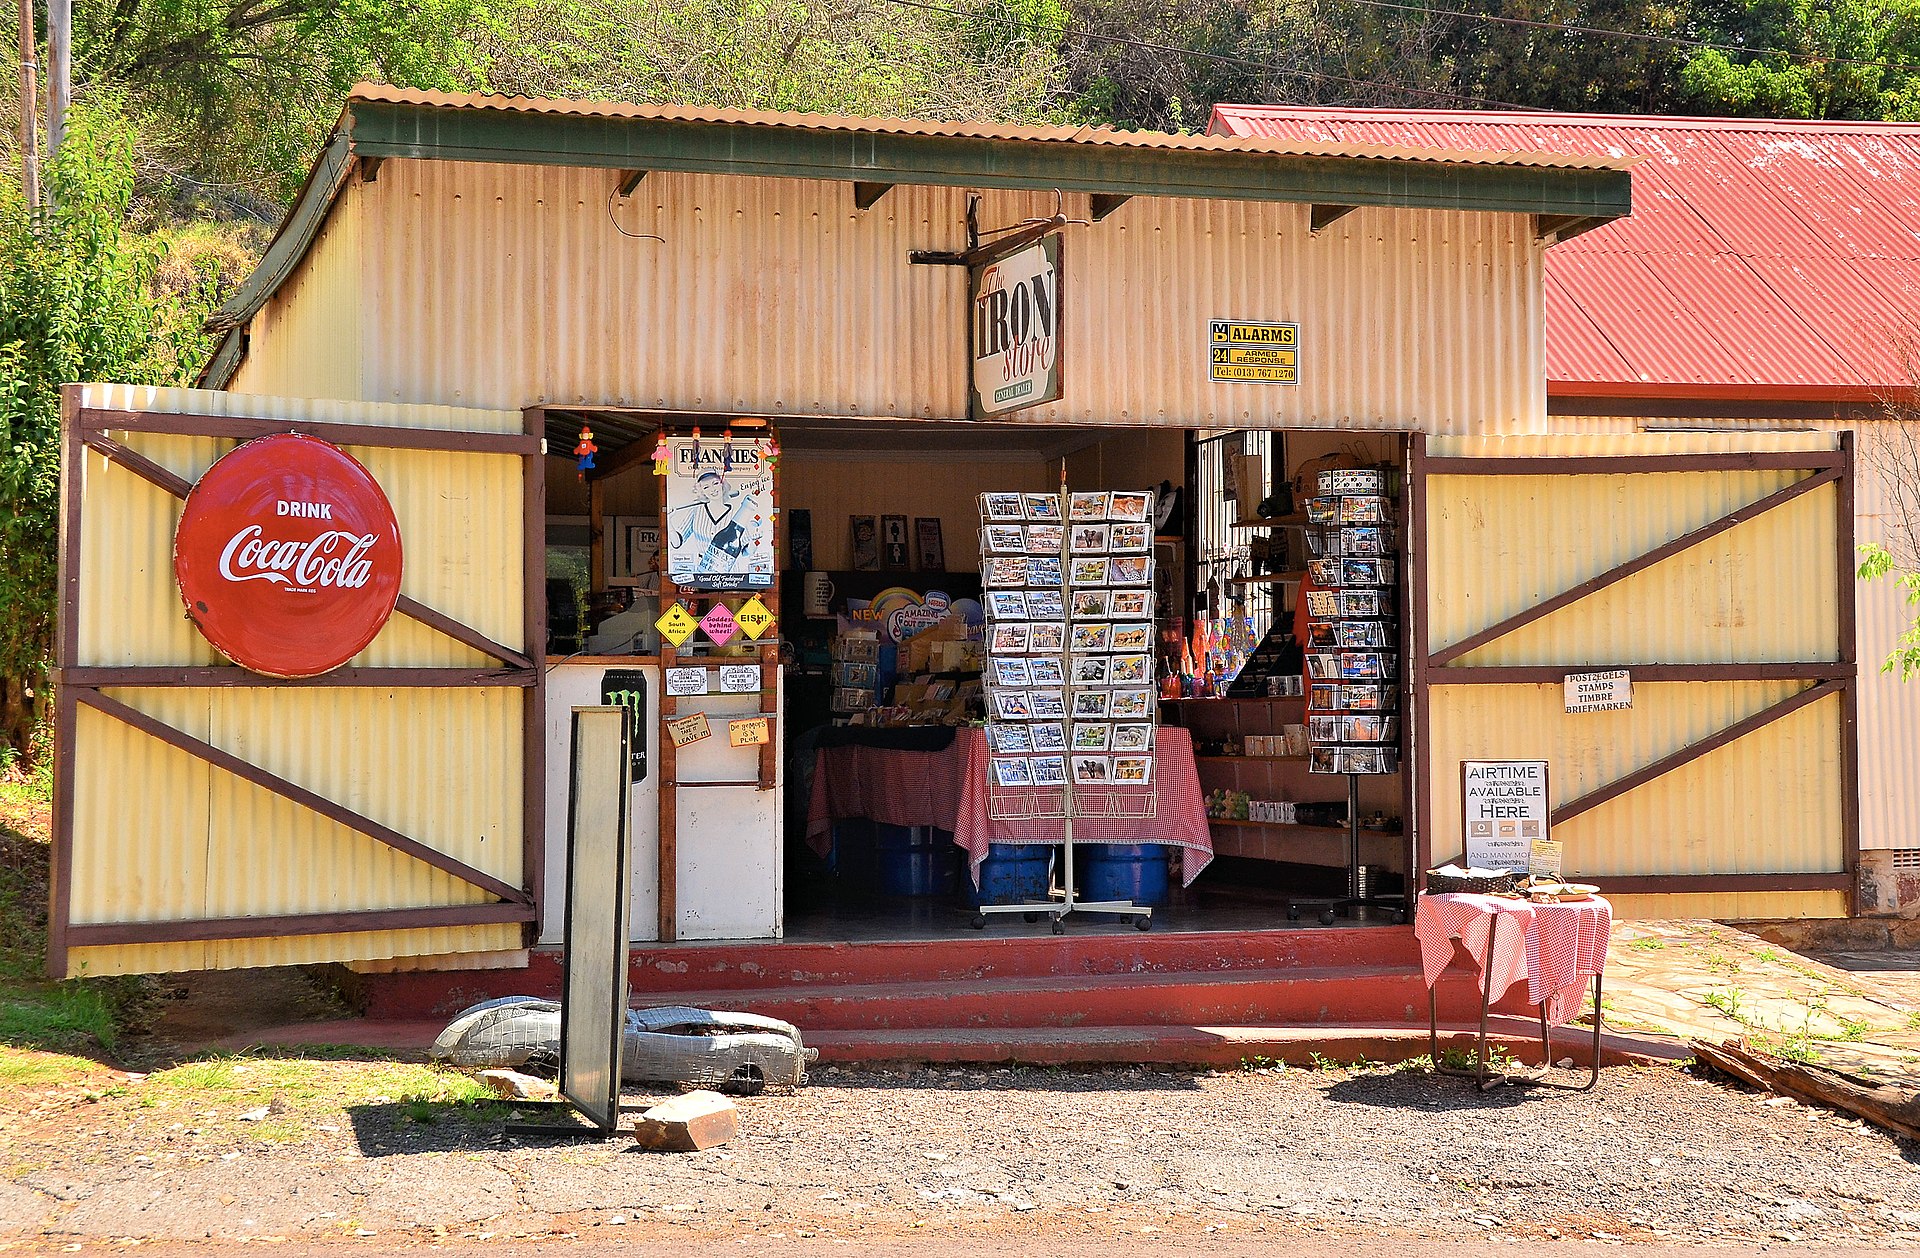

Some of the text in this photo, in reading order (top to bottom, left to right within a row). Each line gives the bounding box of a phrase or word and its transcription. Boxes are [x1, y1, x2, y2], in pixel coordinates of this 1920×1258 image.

[981, 266, 1005, 306] The
[977, 269, 1054, 360] IRON
[1232, 328, 1292, 342] ALARMS
[1003, 335, 1050, 382] store
[1213, 348, 1228, 362] 24
[1244, 350, 1278, 358] ARMED
[1236, 357, 1286, 365] RESPONSE
[1215, 367, 1294, 379] Tel: (013) 767 1270
[996, 381, 1032, 402] GENERAL DEALER
[740, 475, 770, 491] Enjoy ice
[277, 500, 333, 520] DRINK
[218, 525, 381, 589] Coca-Cola
[740, 614, 767, 622] EISH!
[852, 609, 884, 621] NEW
[904, 610, 939, 619] AMAZING
[1569, 670, 1626, 683] POSTZEGELS
[1577, 682, 1614, 692] STAMPS
[1578, 693, 1613, 702] TIMBRE
[1565, 702, 1632, 714] BRIEFMARKEN
[678, 734, 698, 744] LEAVE
[1469, 766, 1538, 779] AIRTIME
[1469, 787, 1541, 797] AVAILABLE
[1480, 804, 1530, 818] HERE
